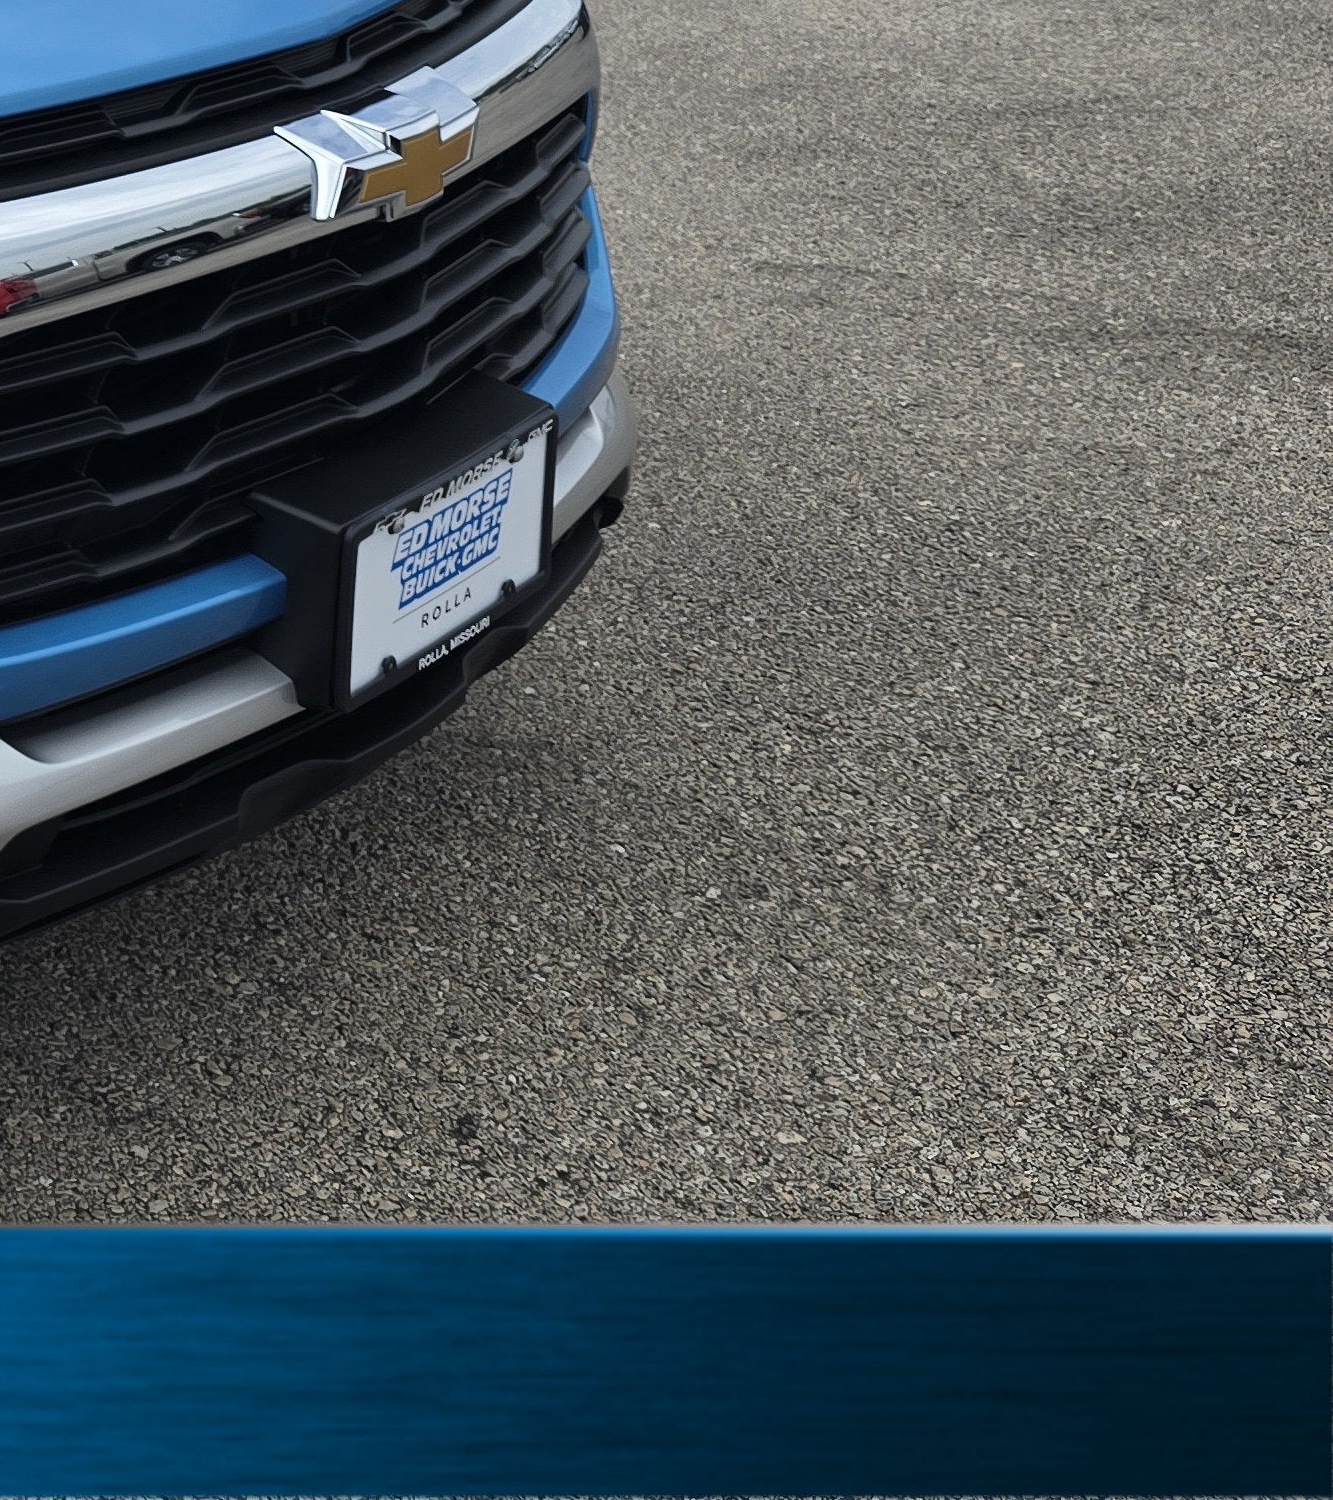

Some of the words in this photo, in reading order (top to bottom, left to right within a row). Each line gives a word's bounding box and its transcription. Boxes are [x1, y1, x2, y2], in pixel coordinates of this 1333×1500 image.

[393, 521, 430, 563] ED
[429, 471, 512, 543] MORSE
[402, 507, 503, 580] CHEVROLET
[421, 586, 471, 628] ROLLA
[418, 644, 449, 671] ROLLA,
[450, 615, 491, 650] MISSOURI
